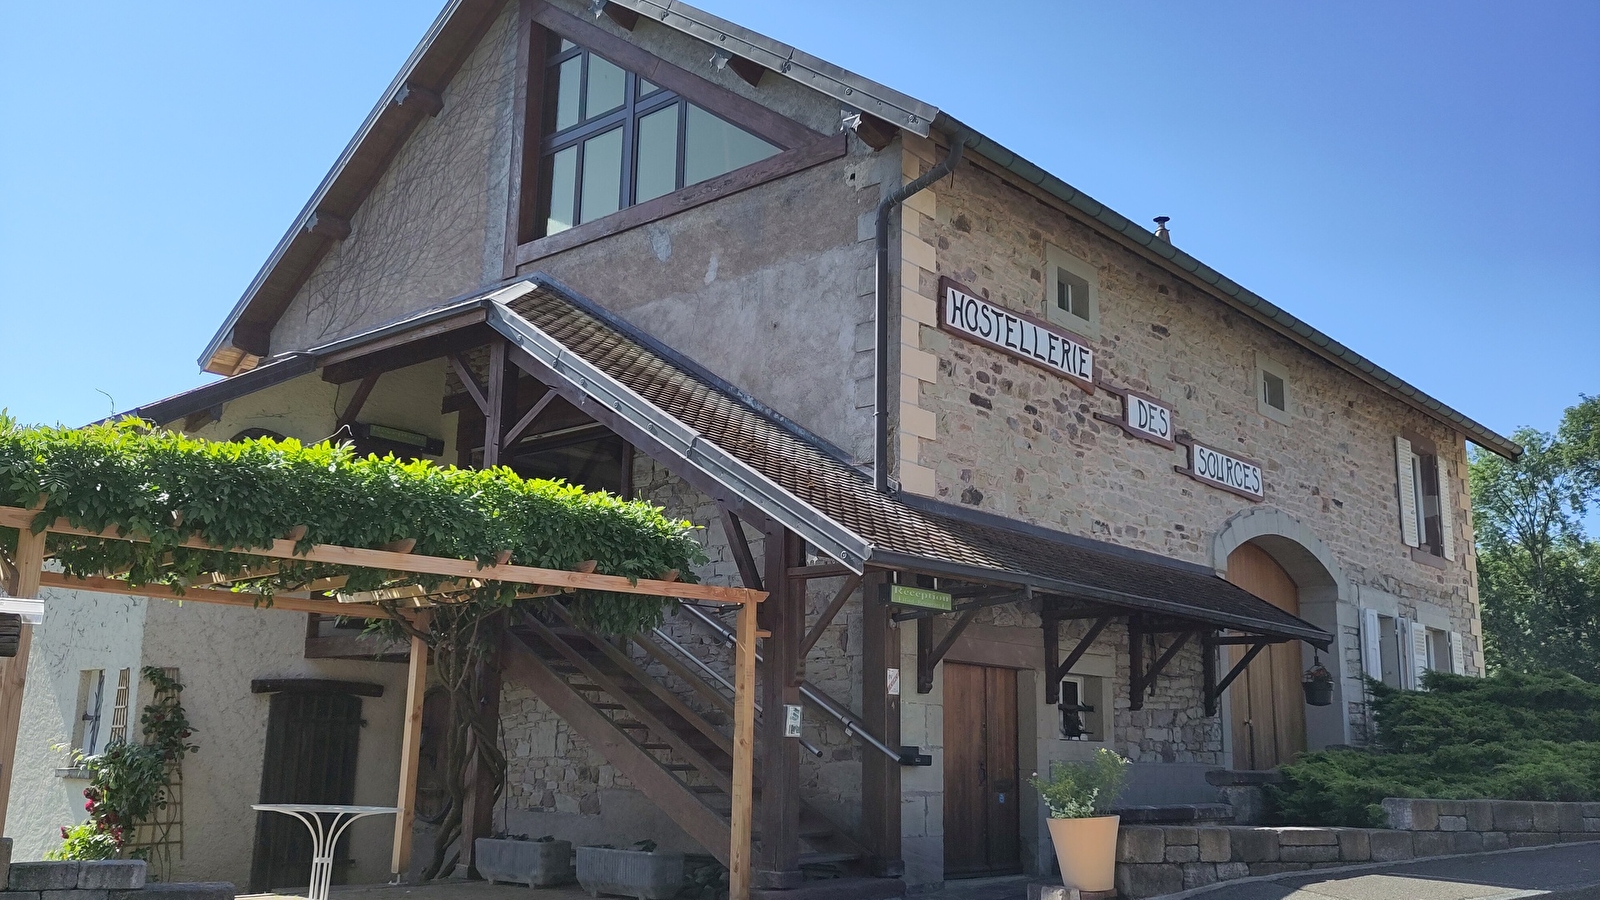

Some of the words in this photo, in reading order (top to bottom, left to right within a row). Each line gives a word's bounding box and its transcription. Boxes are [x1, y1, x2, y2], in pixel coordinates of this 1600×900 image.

[951, 290, 1090, 379] HOSTELLERIE
[1137, 399, 1168, 437] DES
[1198, 448, 1260, 494] SOURCES
